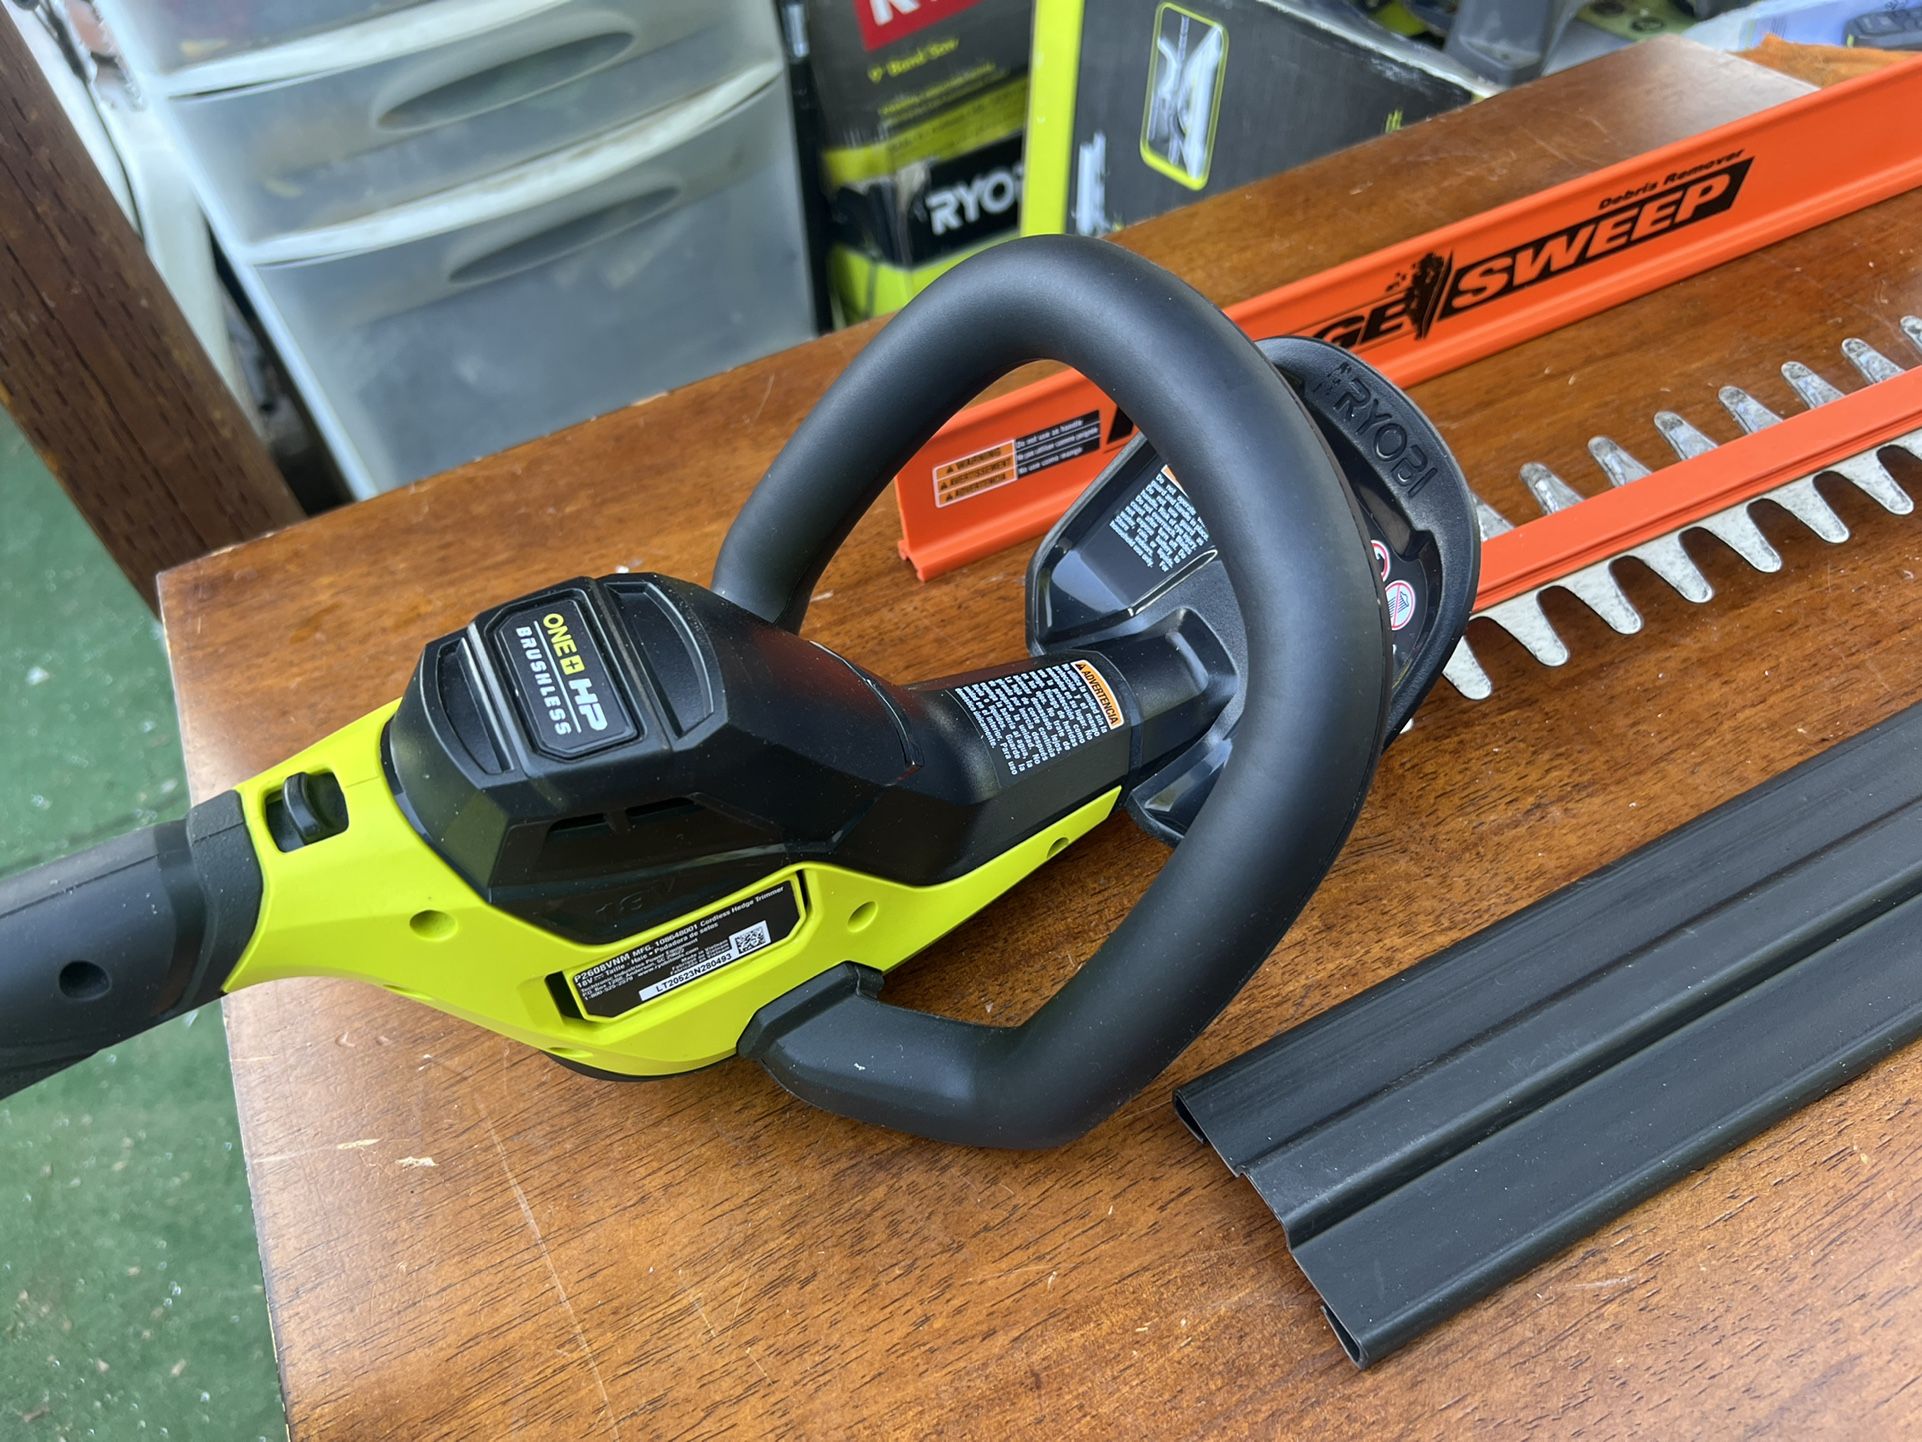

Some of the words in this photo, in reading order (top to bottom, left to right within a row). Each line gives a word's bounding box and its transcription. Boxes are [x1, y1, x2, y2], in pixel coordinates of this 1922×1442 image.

[926, 166, 1023, 235] RYO
[1595, 180, 1660, 210] Debris
[1661, 148, 1747, 185] Remover
[1455, 171, 1732, 306] SWEEP
[1334, 377, 1439, 499] RYOBI
[516, 626, 572, 735] BRUSHLESS
[568, 678, 608, 730] HP
[995, 679, 1013, 697] girando
[1010, 697, 1021, 706] por
[1029, 671, 1045, 688] mango.
[1044, 689, 1059, 709] Riesgo
[1057, 710, 1065, 719] de
[1062, 721, 1081, 747] heridas
[1037, 669, 1047, 678] use
[1051, 688, 1075, 720] protección
[1073, 724, 1085, 743] como
[1045, 666, 1067, 692] montados
[1052, 665, 1076, 693] protección
[1082, 713, 1100, 736] mango
[1067, 670, 1082, 686] utilice
[1083, 692, 1100, 714] unidad
[1095, 715, 1104, 725] sin
[1100, 725, 1107, 733] la
[1069, 700, 1078, 708] su
[1083, 670, 1118, 724] ADVERTENCIA
[955, 687, 976, 711] doméstico
[973, 711, 1002, 748] únicamente.
[963, 685, 980, 702] unidad
[983, 716, 1003, 741] interior.
[1000, 742, 1015, 759] Para
[1008, 761, 1017, 775] uso
[972, 684, 985, 696] lluvia
[988, 705, 1006, 730] líquidos.
[1000, 734, 1024, 759] Guarde
[1018, 763, 1028, 771] la
[980, 682, 998, 701] exponga
[1000, 708, 1016, 729] batería
[1012, 739, 1028, 759] agua,
[1026, 760, 1033, 768] la
[995, 686, 1015, 711] apagarse
[1015, 724, 1038, 750] unidad.
[1032, 754, 1043, 764] No
[1011, 684, 1022, 695] hoja
[1028, 707, 1040, 723] corte
[1035, 727, 1060, 757] continúa
[1013, 675, 1032, 694] alcanzar
[1031, 697, 1053, 730] demasiado
[1049, 734, 1067, 754] lejos.
[1019, 707, 1034, 729] inercia
[1026, 732, 1053, 761] después
[1028, 680, 1037, 689] los
[1036, 691, 1047, 704] ojos.
[1046, 707, 1055, 717] No
[1051, 720, 1065, 737] trate
[1063, 741, 1070, 750] de
[1072, 709, 1087, 728] lugar.
[1085, 730, 1092, 740] No
[573, 953, 630, 982] P2608VNM
[632, 945, 653, 957] MFG.
[700, 911, 730, 926] Cordless
[732, 900, 754, 913] Hedge
[755, 887, 783, 902] Trimmer
[577, 977, 592, 988] 18V
[605, 964, 625, 975] Taille
[631, 954, 647, 964] Haie
[654, 936, 688, 954] Podadora
[699, 922, 718, 934] setos
[656, 958, 730, 992] LT20523N280493
